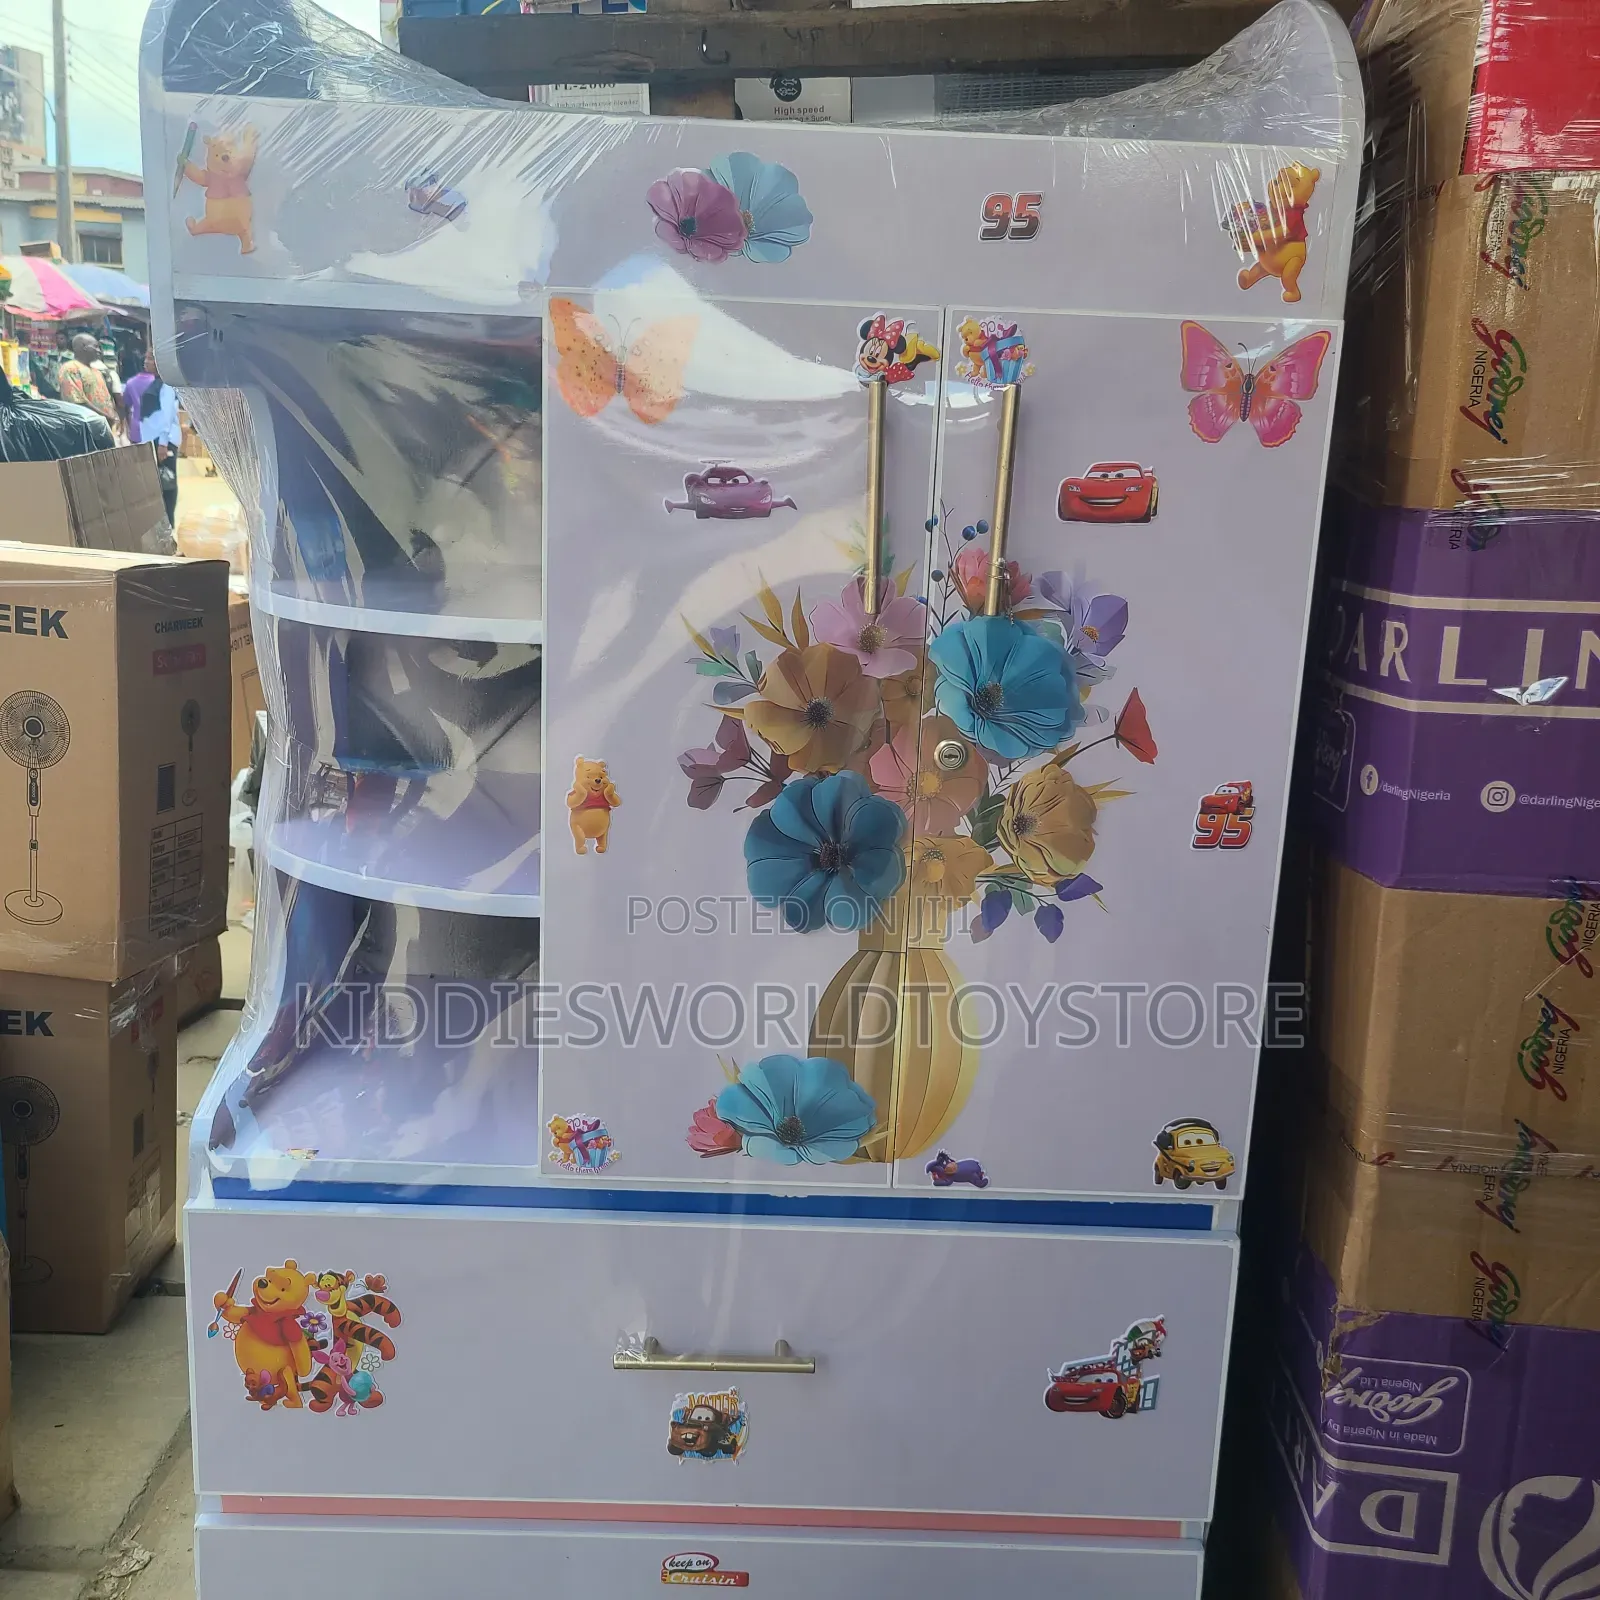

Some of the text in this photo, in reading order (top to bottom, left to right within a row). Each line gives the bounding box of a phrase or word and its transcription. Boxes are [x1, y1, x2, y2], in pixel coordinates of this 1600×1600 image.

[774, 105, 825, 116] High speed
[980, 192, 1043, 241] 95
[1468, 350, 1488, 409] NIGERIA
[155, 617, 204, 633] CHARWEEK
[1192, 806, 1256, 850] 95
[1552, 1028, 1572, 1076] NIGERIA
[1471, 1277, 1486, 1323] NIGERIA
[1381, 1376, 1423, 1392] Nigeria
[1327, 1418, 1438, 1445] Made in Nigeria by
[668, 1556, 694, 1570] keep
[669, 1573, 739, 1585] Cruisin'
